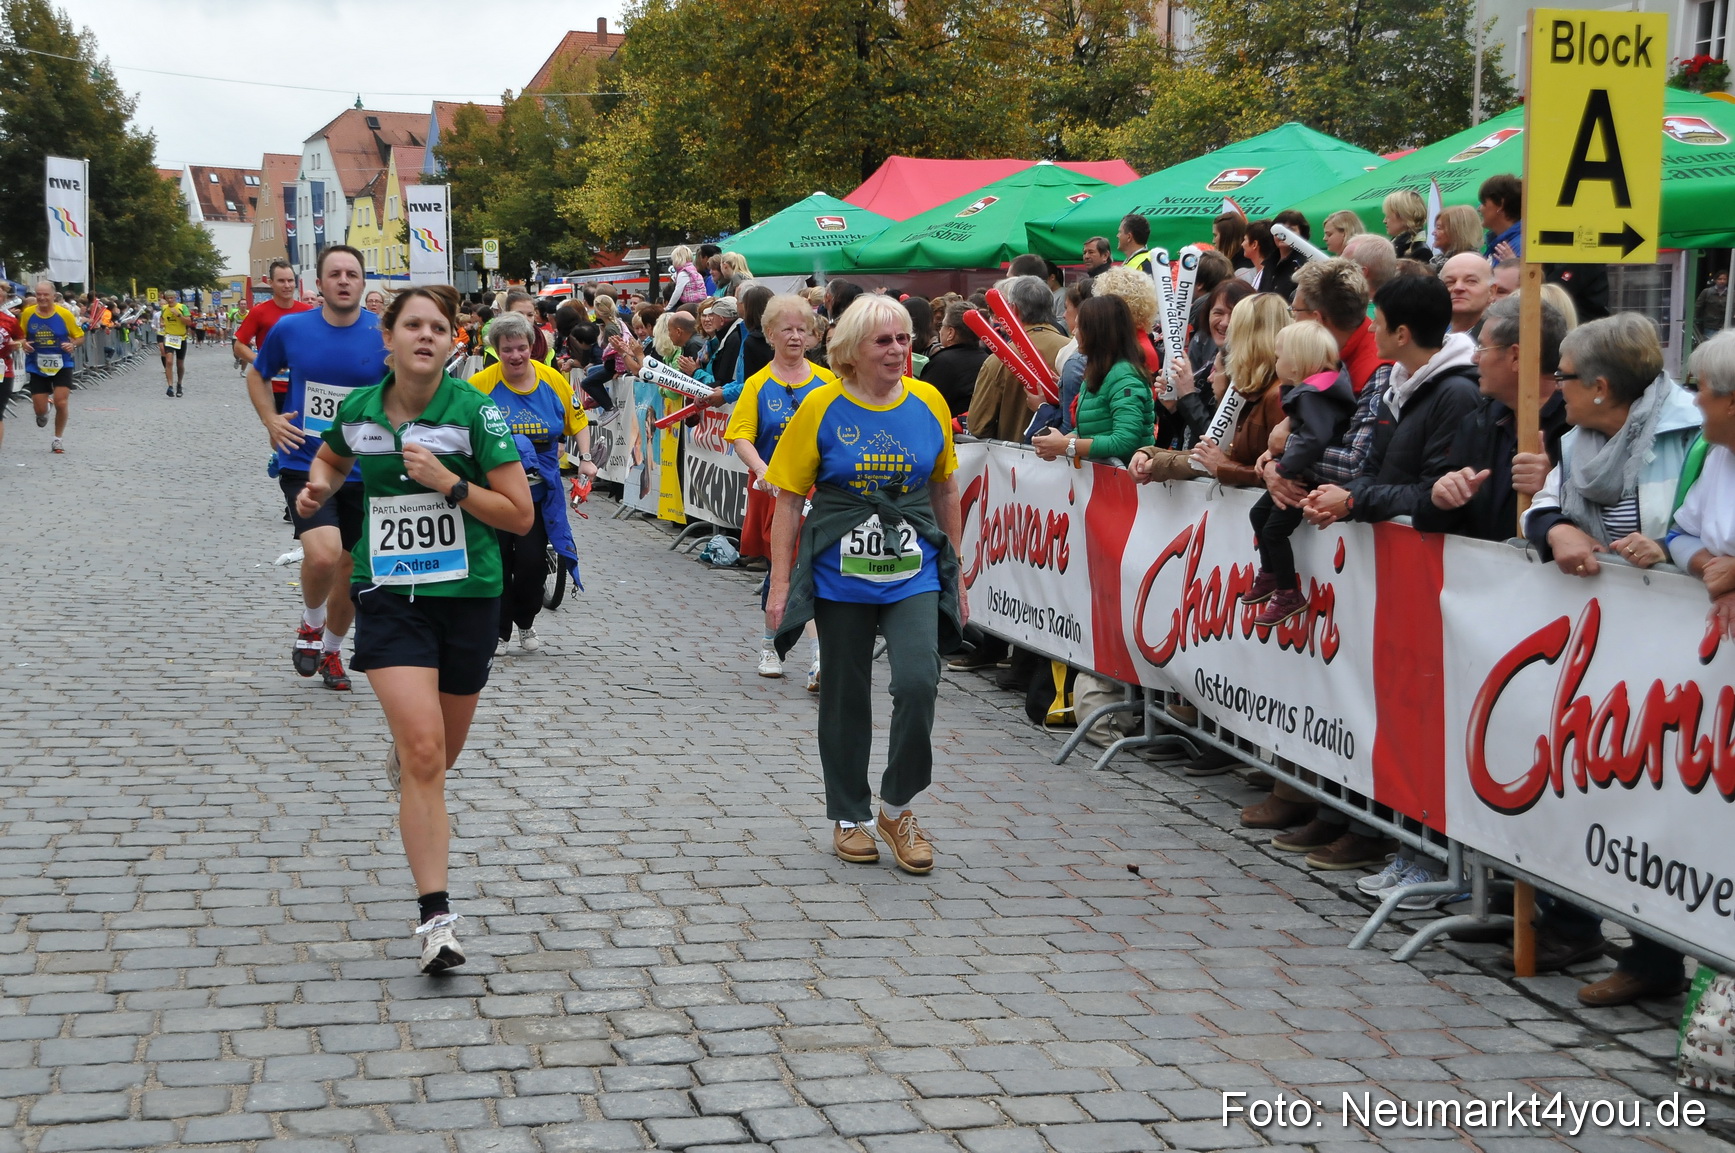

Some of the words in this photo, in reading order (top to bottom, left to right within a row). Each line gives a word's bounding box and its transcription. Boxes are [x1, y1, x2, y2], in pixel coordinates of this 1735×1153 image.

[1551, 20, 1652, 68] Block
[1556, 89, 1632, 208] A
[1129, 204, 1271, 216] Lammsbäu
[657, 376, 680, 389] BMW
[373, 505, 398, 515] PARTL
[400, 502, 445, 514] Neumarkt
[380, 514, 456, 551] 2690
[849, 528, 914, 556] 502
[395, 558, 440, 573] Andrea
[868, 561, 895, 573] Irene
[987, 585, 1045, 631] Ostbayerns
[1048, 607, 1082, 644] Radio
[1194, 667, 1298, 734] Ostbayerns
[1302, 705, 1355, 760] Radio
